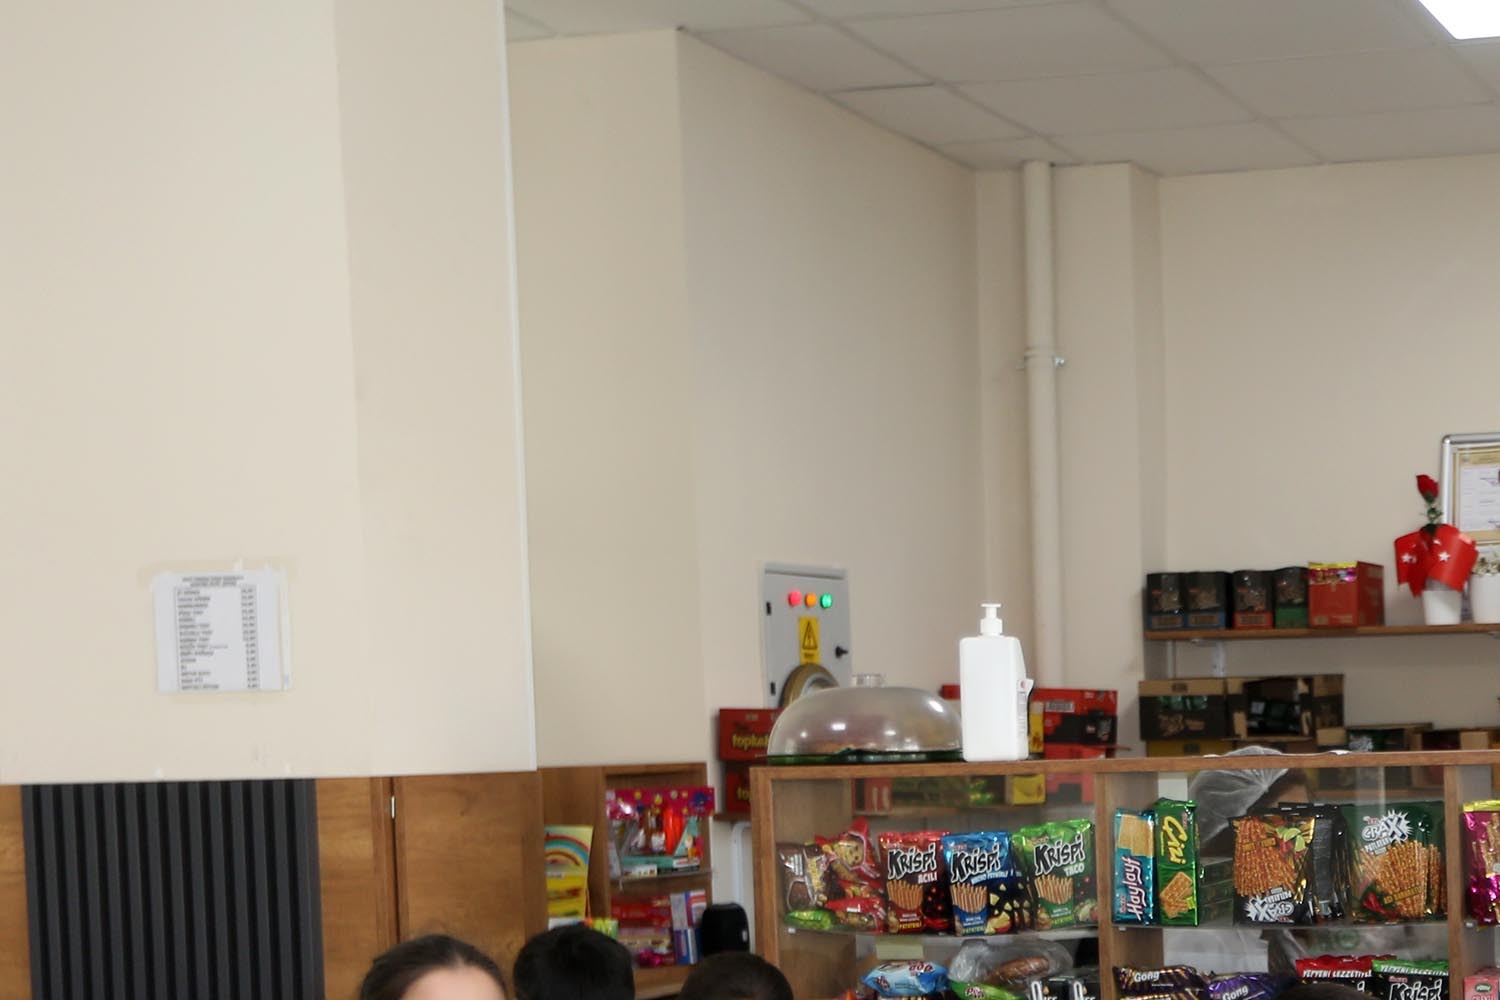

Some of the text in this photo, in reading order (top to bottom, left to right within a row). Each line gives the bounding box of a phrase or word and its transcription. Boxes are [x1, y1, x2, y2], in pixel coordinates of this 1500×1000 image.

[1362, 815, 1408, 842] CRAX
[1121, 856, 1147, 921] Haylayf
[1134, 971, 1160, 983] Gong
